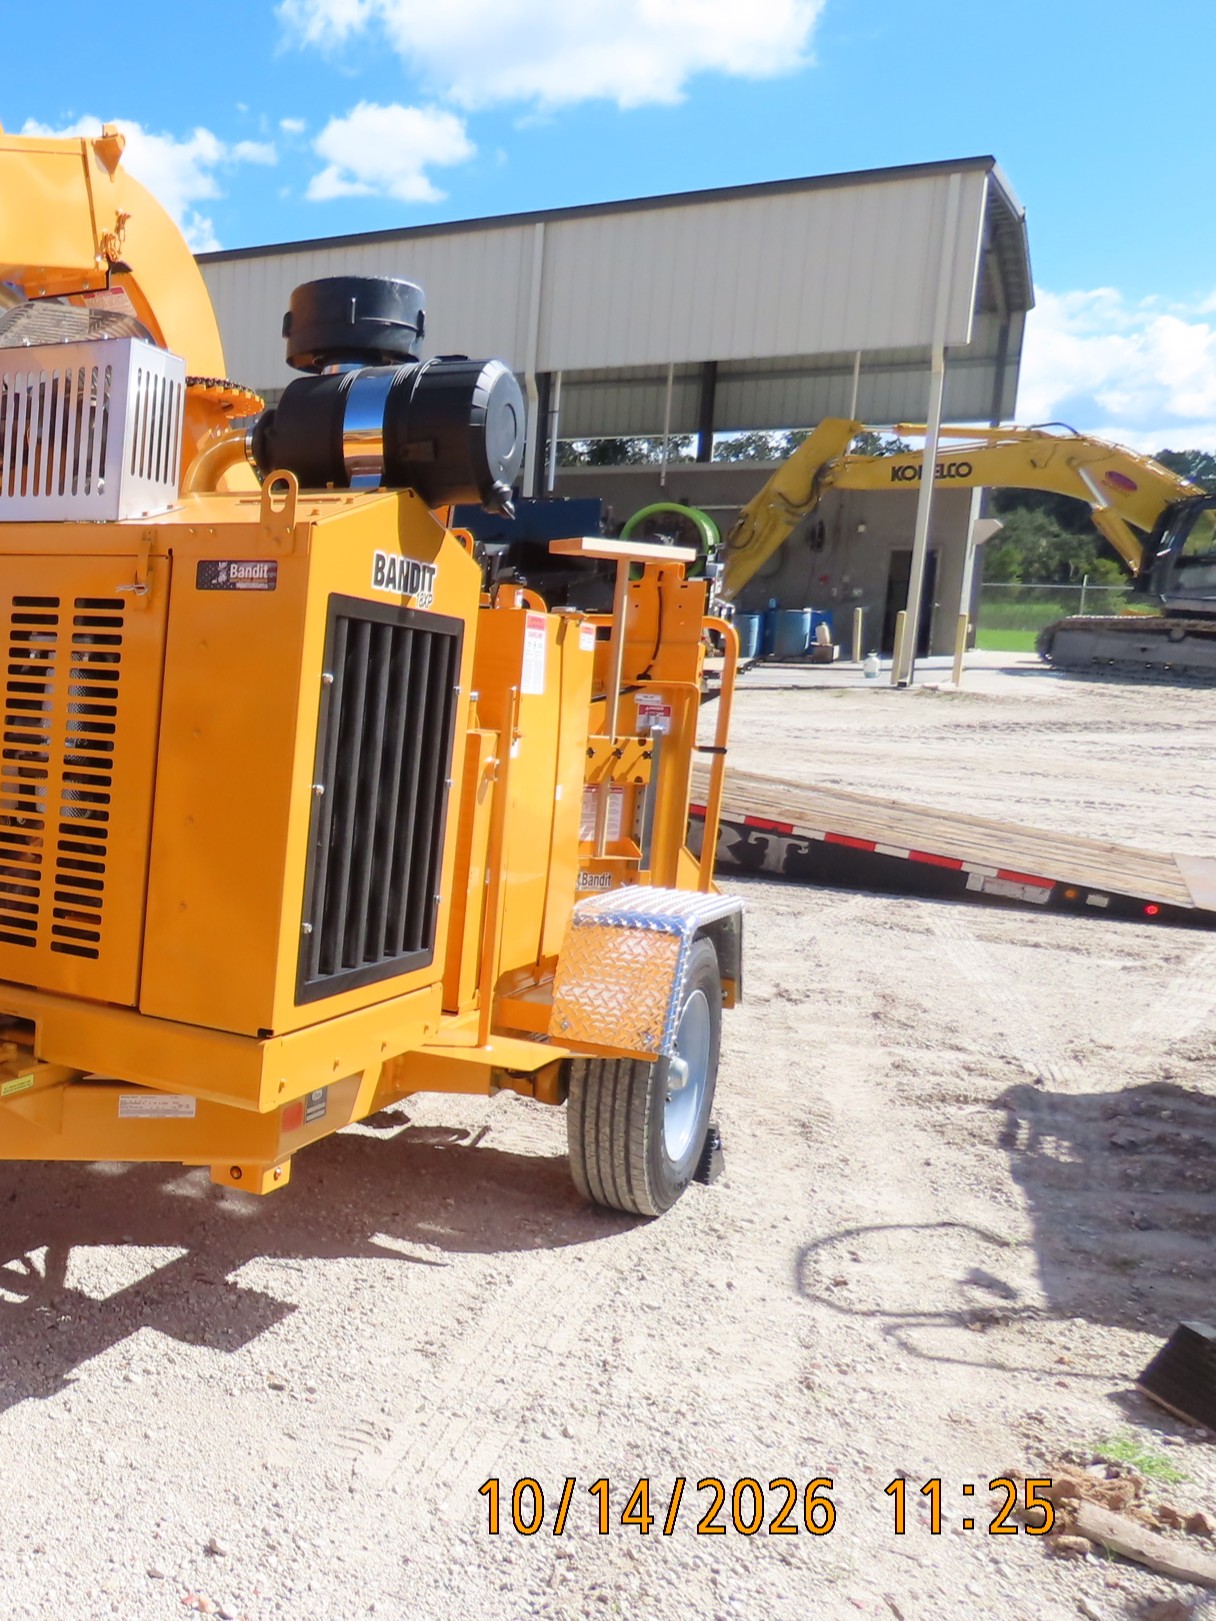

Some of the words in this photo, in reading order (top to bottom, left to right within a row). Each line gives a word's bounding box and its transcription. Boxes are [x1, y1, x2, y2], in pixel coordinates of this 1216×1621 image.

[229, 563, 269, 578] Bandit
[373, 553, 436, 594] BANDIT
[582, 872, 612, 886] Bandit
